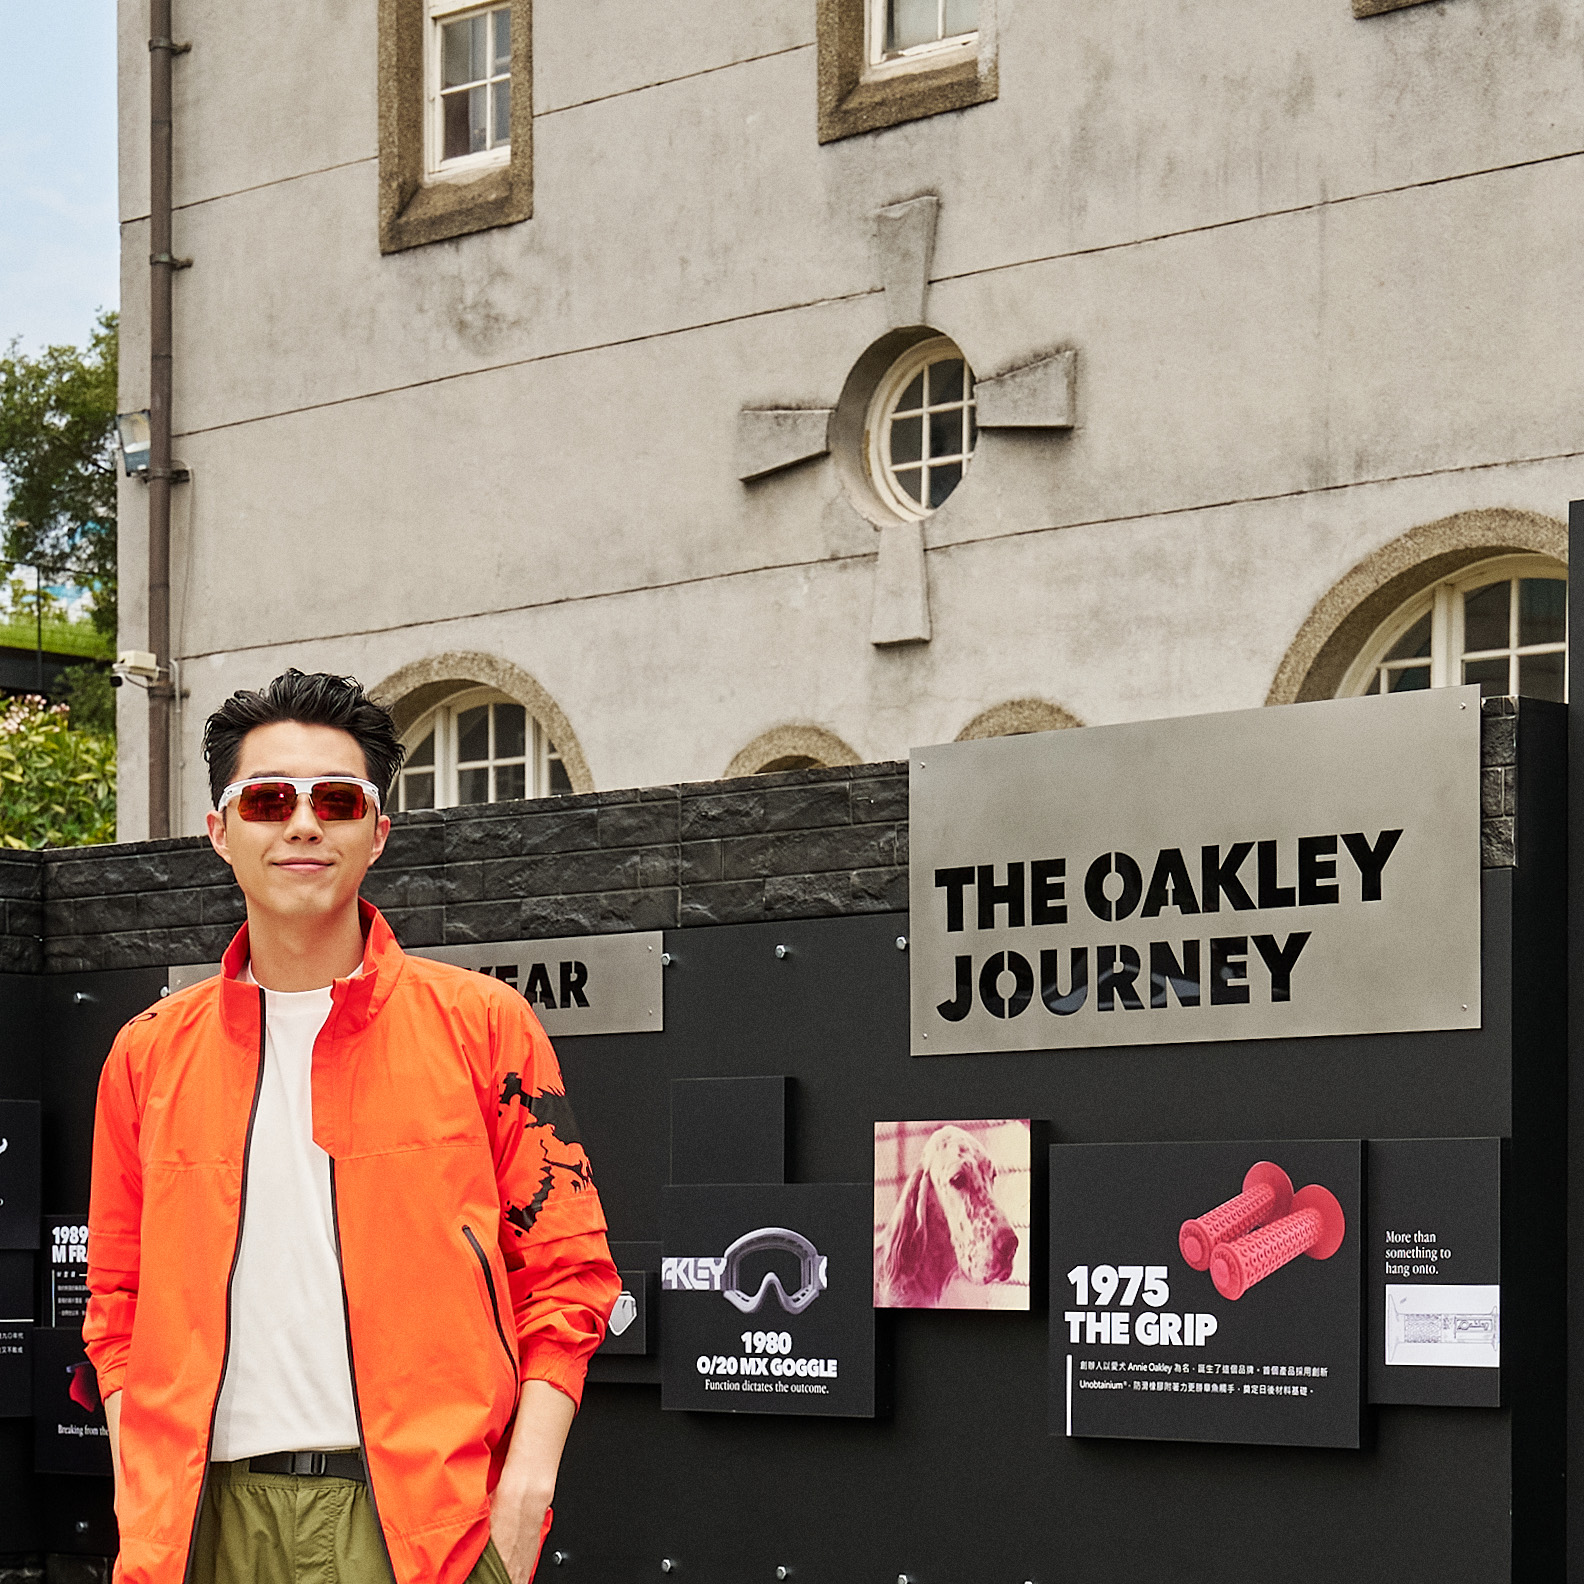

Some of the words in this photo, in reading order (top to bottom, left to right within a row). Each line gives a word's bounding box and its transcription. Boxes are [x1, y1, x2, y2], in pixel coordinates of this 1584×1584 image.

[935, 857, 1068, 933] THE
[1084, 829, 1404, 923] OAKLEY
[464, 960, 591, 1010] EAR
[936, 931, 1313, 1023] JOURNEY
[52, 1226, 89, 1245] 1989
[1385, 1230, 1412, 1243] More
[1413, 1230, 1437, 1243] than
[52, 1245, 66, 1263] M
[69, 1245, 88, 1263] FR
[1385, 1245, 1438, 1262] something
[1439, 1248, 1452, 1259] to
[1385, 1261, 1411, 1277] hang
[1412, 1264, 1439, 1275] onto.
[1066, 1264, 1170, 1308] 1975
[1064, 1311, 1131, 1346] THE
[1135, 1312, 1218, 1347] GRIP
[740, 1331, 792, 1355] 1980
[696, 1355, 738, 1376] O/20
[740, 1357, 769, 1376] MX
[770, 1358, 838, 1378] GOGGLE
[1127, 1362, 1148, 1373] Annie
[1148, 1362, 1172, 1375] Oakley
[704, 1379, 741, 1391] Function
[741, 1380, 774, 1392] dictates
[775, 1381, 790, 1393] the
[790, 1383, 830, 1394] outcome.
[57, 1424, 84, 1437] Breaking
[84, 1424, 99, 1436] from
